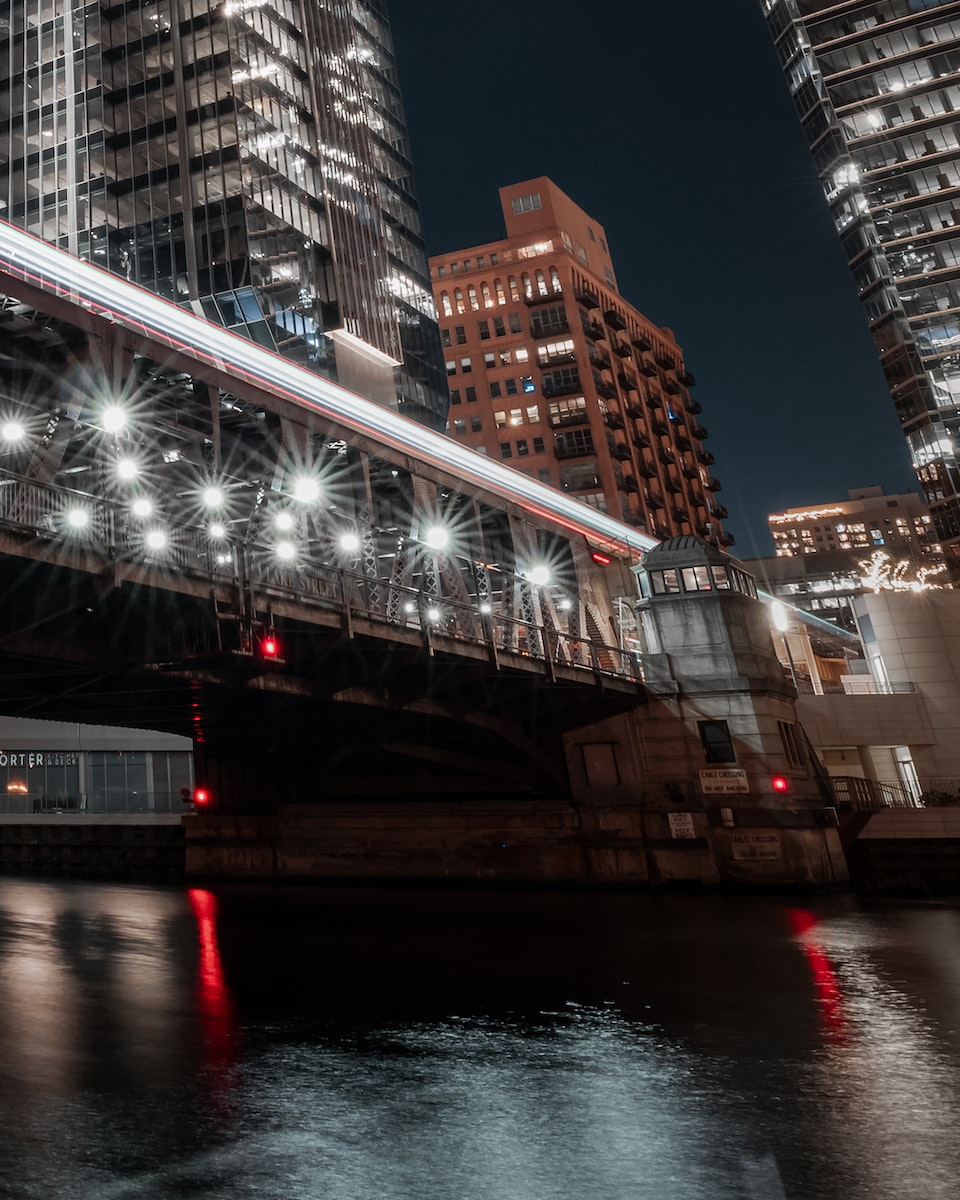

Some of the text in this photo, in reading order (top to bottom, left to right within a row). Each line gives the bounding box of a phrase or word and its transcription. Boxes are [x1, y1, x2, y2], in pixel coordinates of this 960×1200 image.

[266, 566, 338, 599] LAKE STREET
[54, 758, 77, 766] DECK
